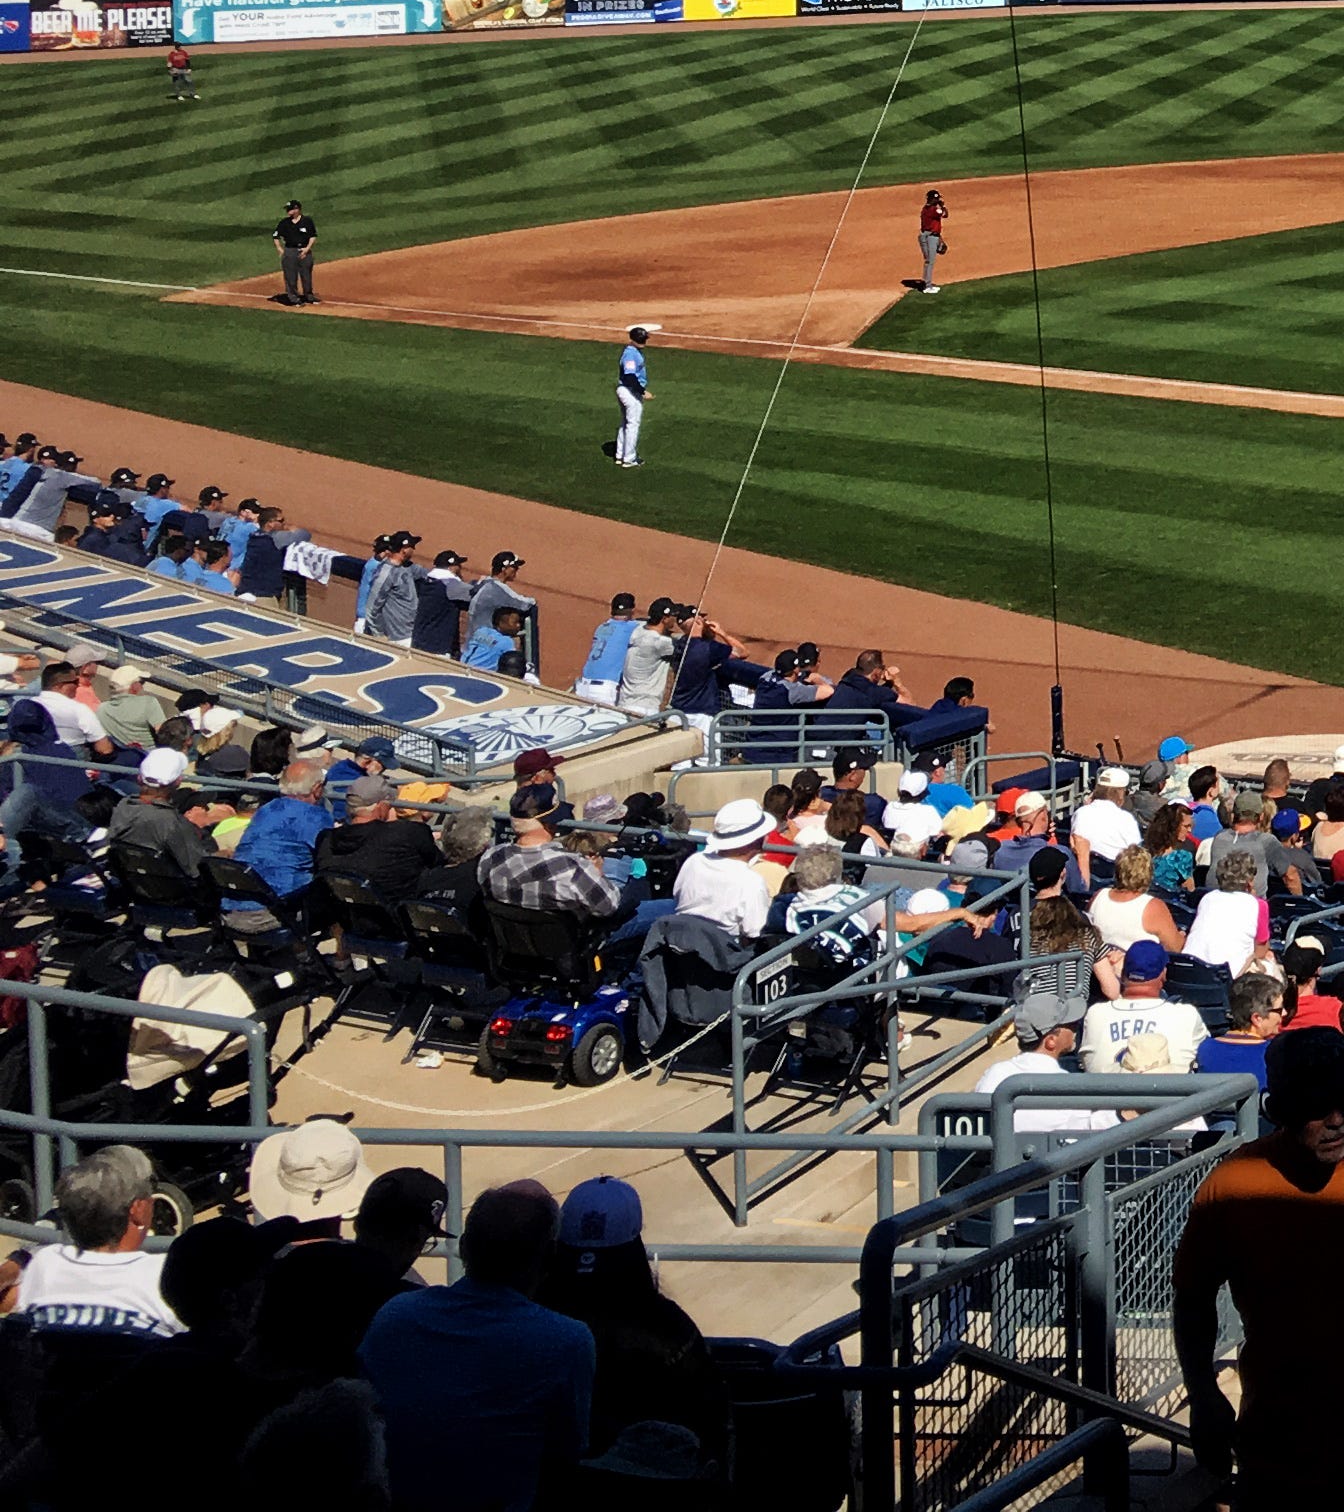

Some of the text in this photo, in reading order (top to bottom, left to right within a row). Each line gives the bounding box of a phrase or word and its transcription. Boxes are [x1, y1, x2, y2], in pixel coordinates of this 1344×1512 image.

[108, 6, 172, 32] PLEASE!
[232, 12, 265, 22] YOUR
[0, 538, 512, 730] INERS
[944, 1116, 984, 1138] 101
